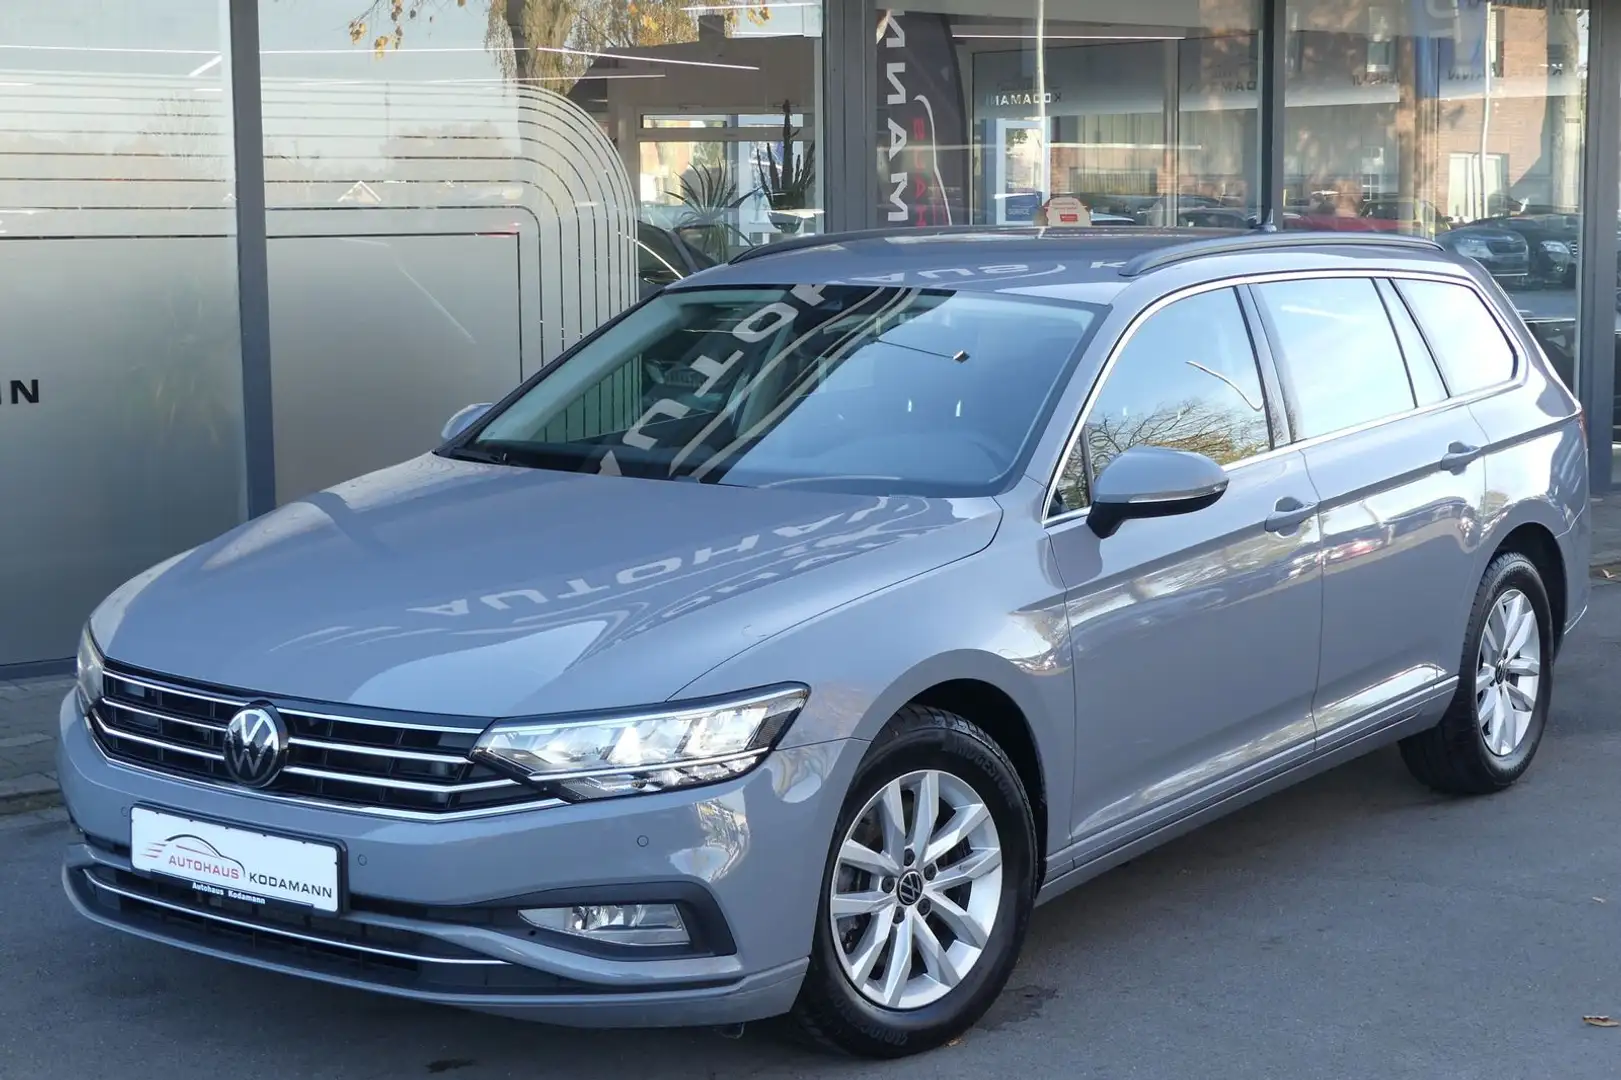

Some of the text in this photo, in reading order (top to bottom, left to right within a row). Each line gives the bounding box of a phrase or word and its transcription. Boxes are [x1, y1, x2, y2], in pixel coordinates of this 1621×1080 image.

[168, 855, 332, 898] AUTOHAUS KODAMANN
[192, 882, 266, 904] Autohaus Kodamann
